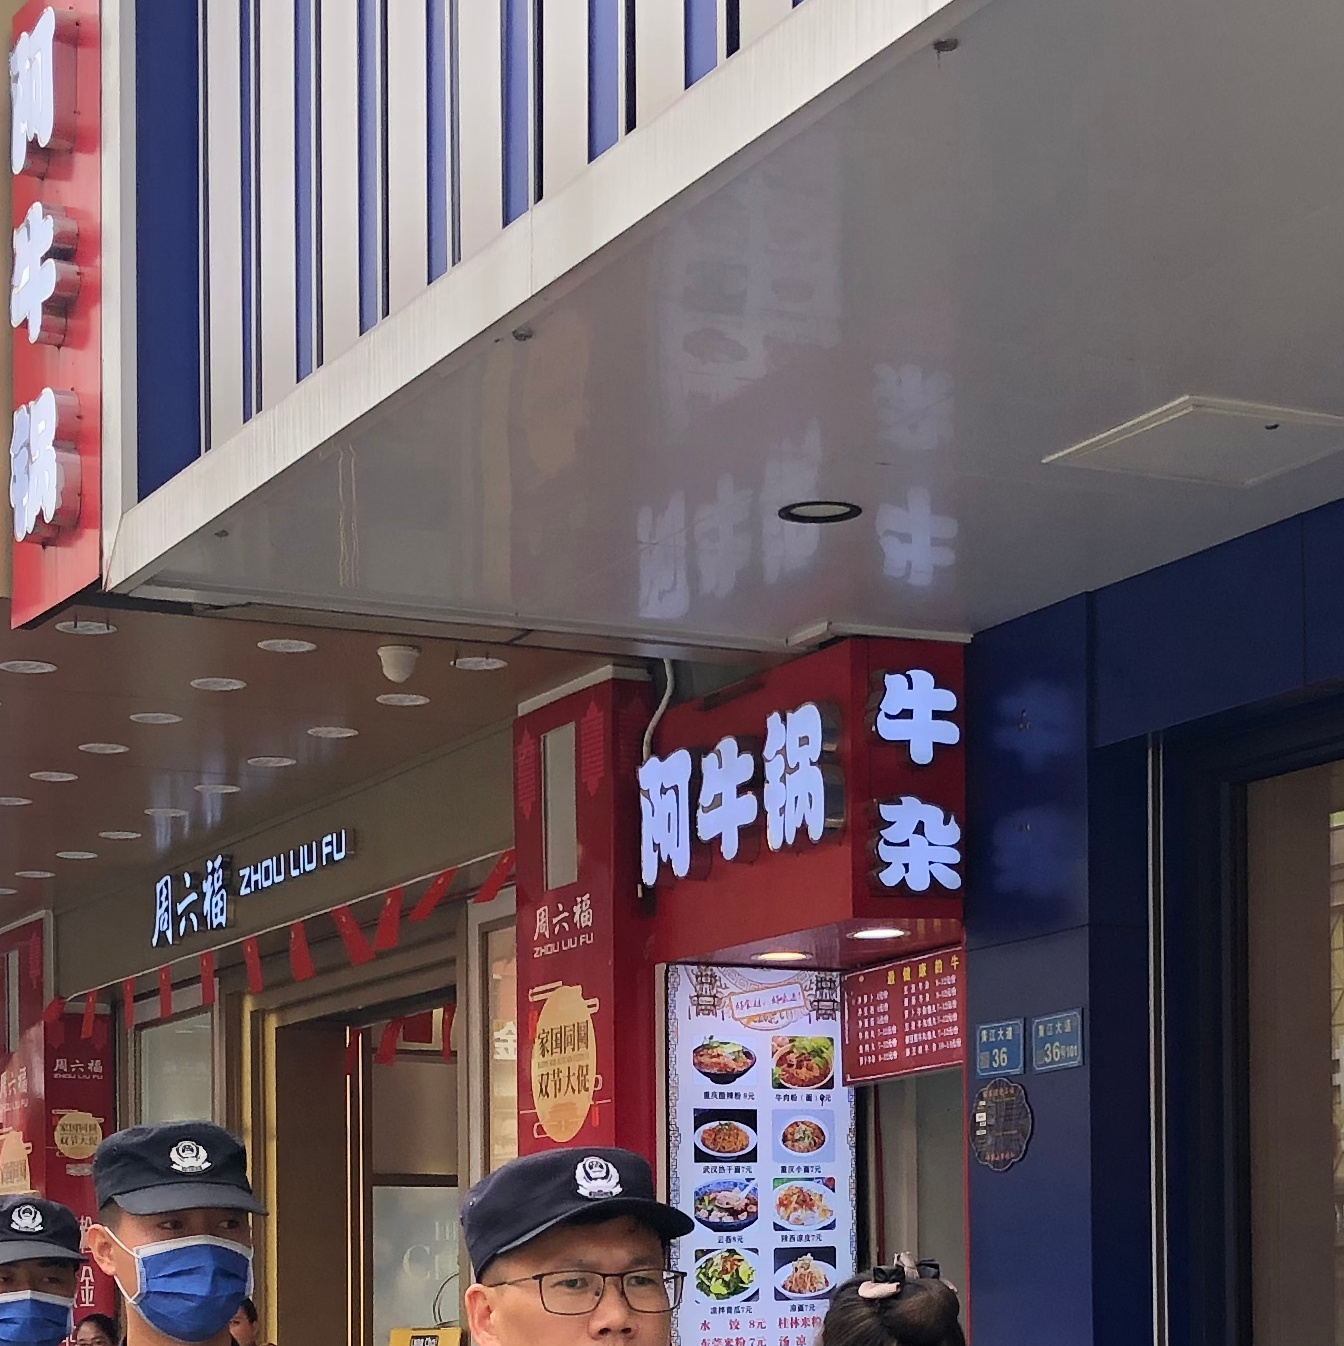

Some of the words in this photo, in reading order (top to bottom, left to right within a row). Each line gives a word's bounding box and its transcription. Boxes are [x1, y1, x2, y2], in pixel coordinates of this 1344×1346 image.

[9, 5, 56, 542] 阿牛锅
[638, 701, 828, 887] 阿牛锅
[877, 669, 961, 891] 牛杂
[239, 854, 284, 896] ZHOU
[290, 841, 317, 877] LIU
[322, 829, 346, 866] FU
[152, 854, 227, 947] 周六福
[533, 893, 594, 941] 周六福
[533, 941, 560, 958] ZHOU
[561, 936, 578, 950] LIU
[580, 932, 594, 945] FU
[537, 1064, 590, 1101] 双节大促
[992, 1047, 1008, 1068] 36
